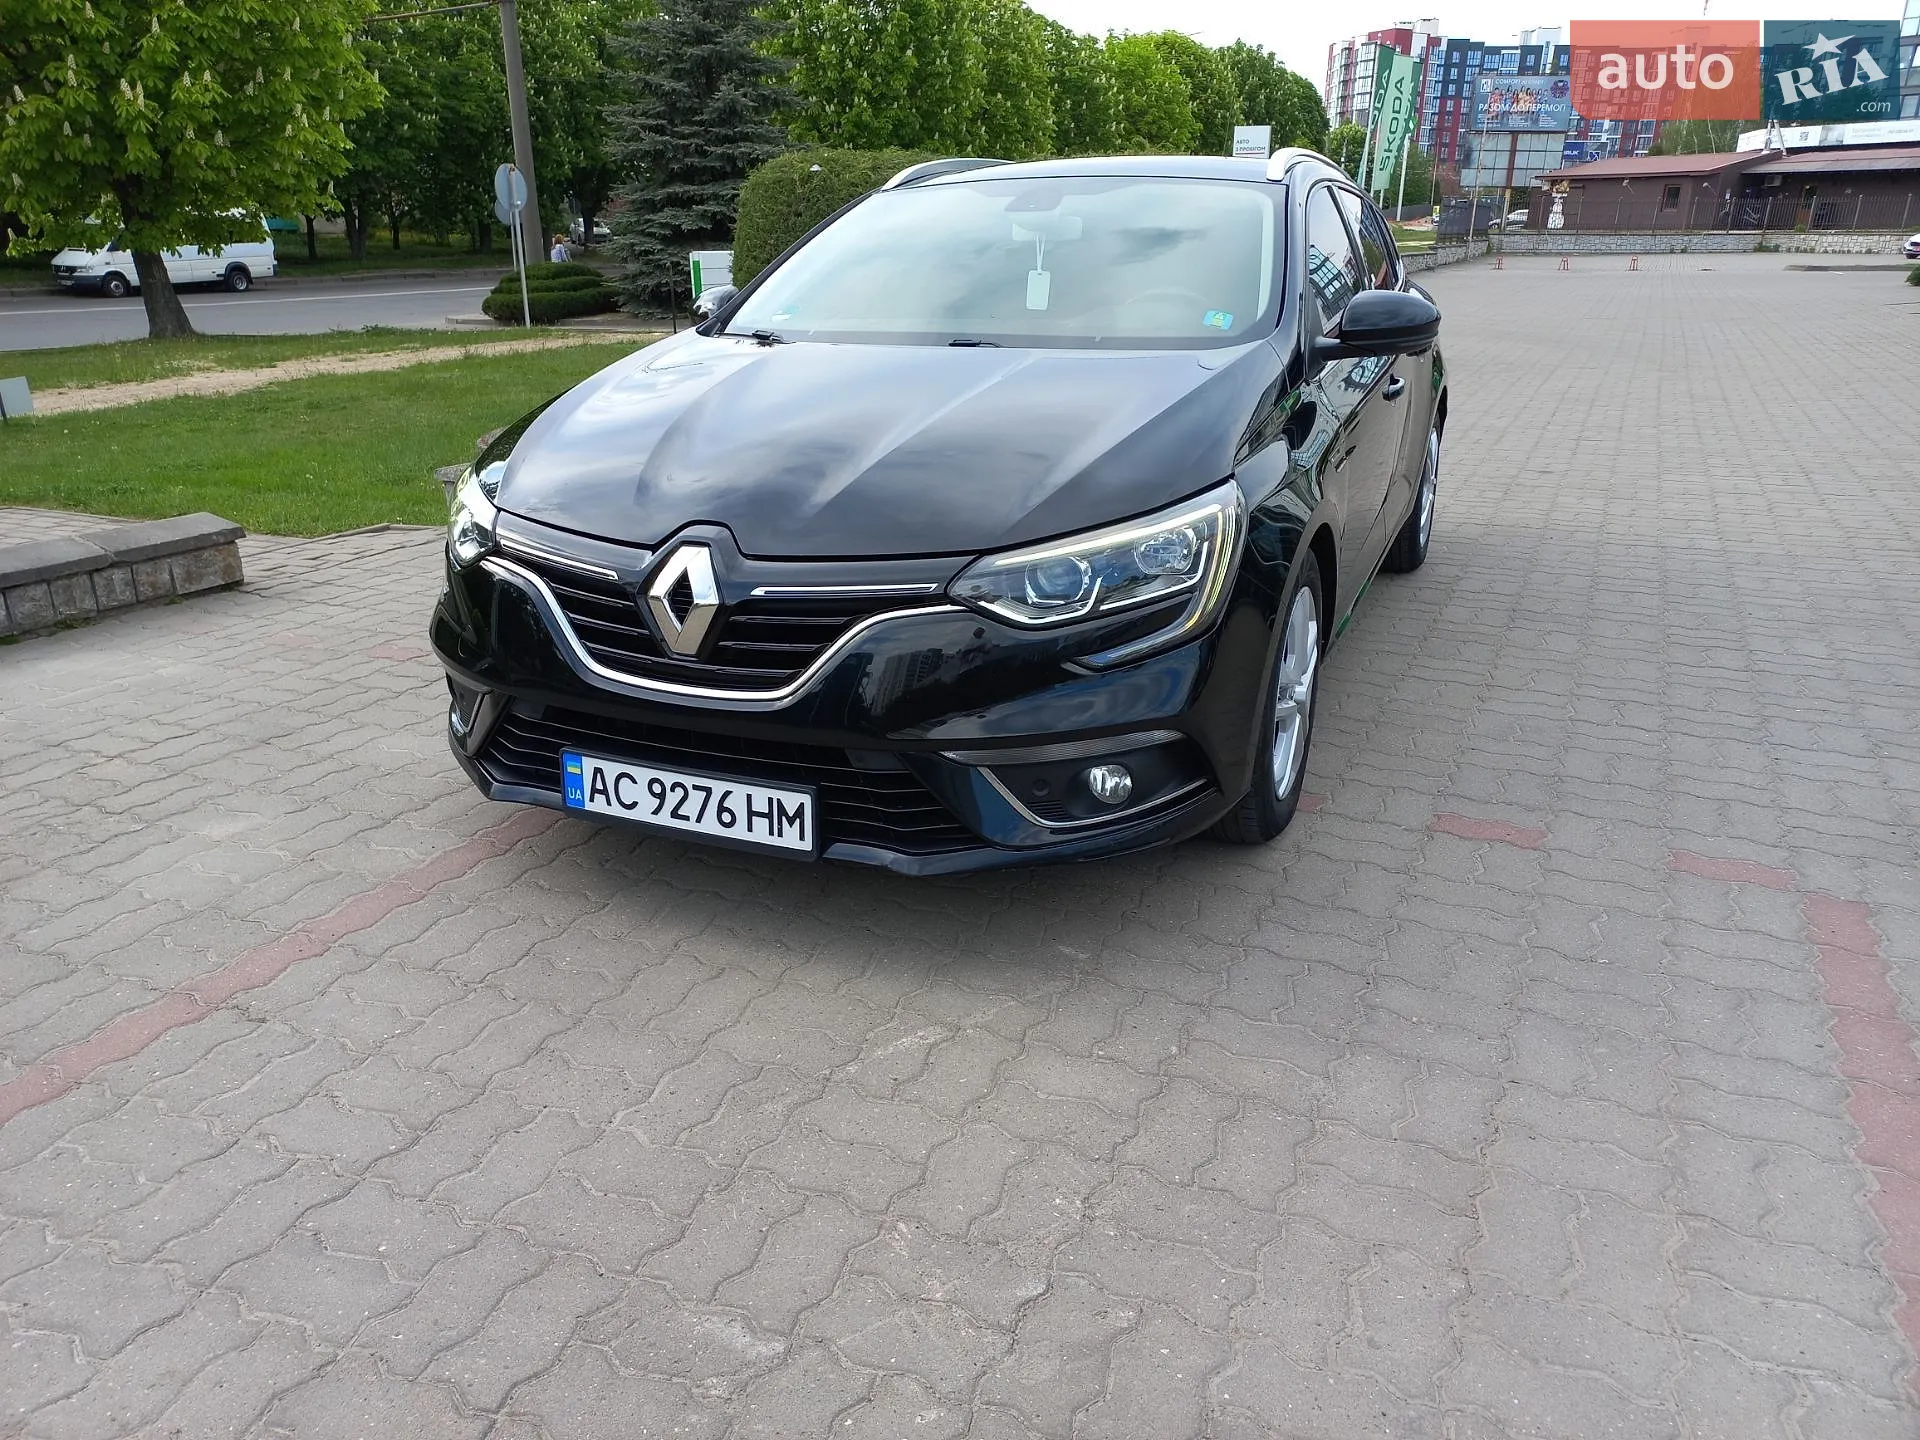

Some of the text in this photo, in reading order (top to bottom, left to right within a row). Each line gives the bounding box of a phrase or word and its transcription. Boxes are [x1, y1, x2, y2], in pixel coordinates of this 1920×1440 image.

[1478, 103, 1509, 112] РАЗОМ
[568, 787, 583, 801] UA
[589, 766, 806, 841] AC 9276 HM
